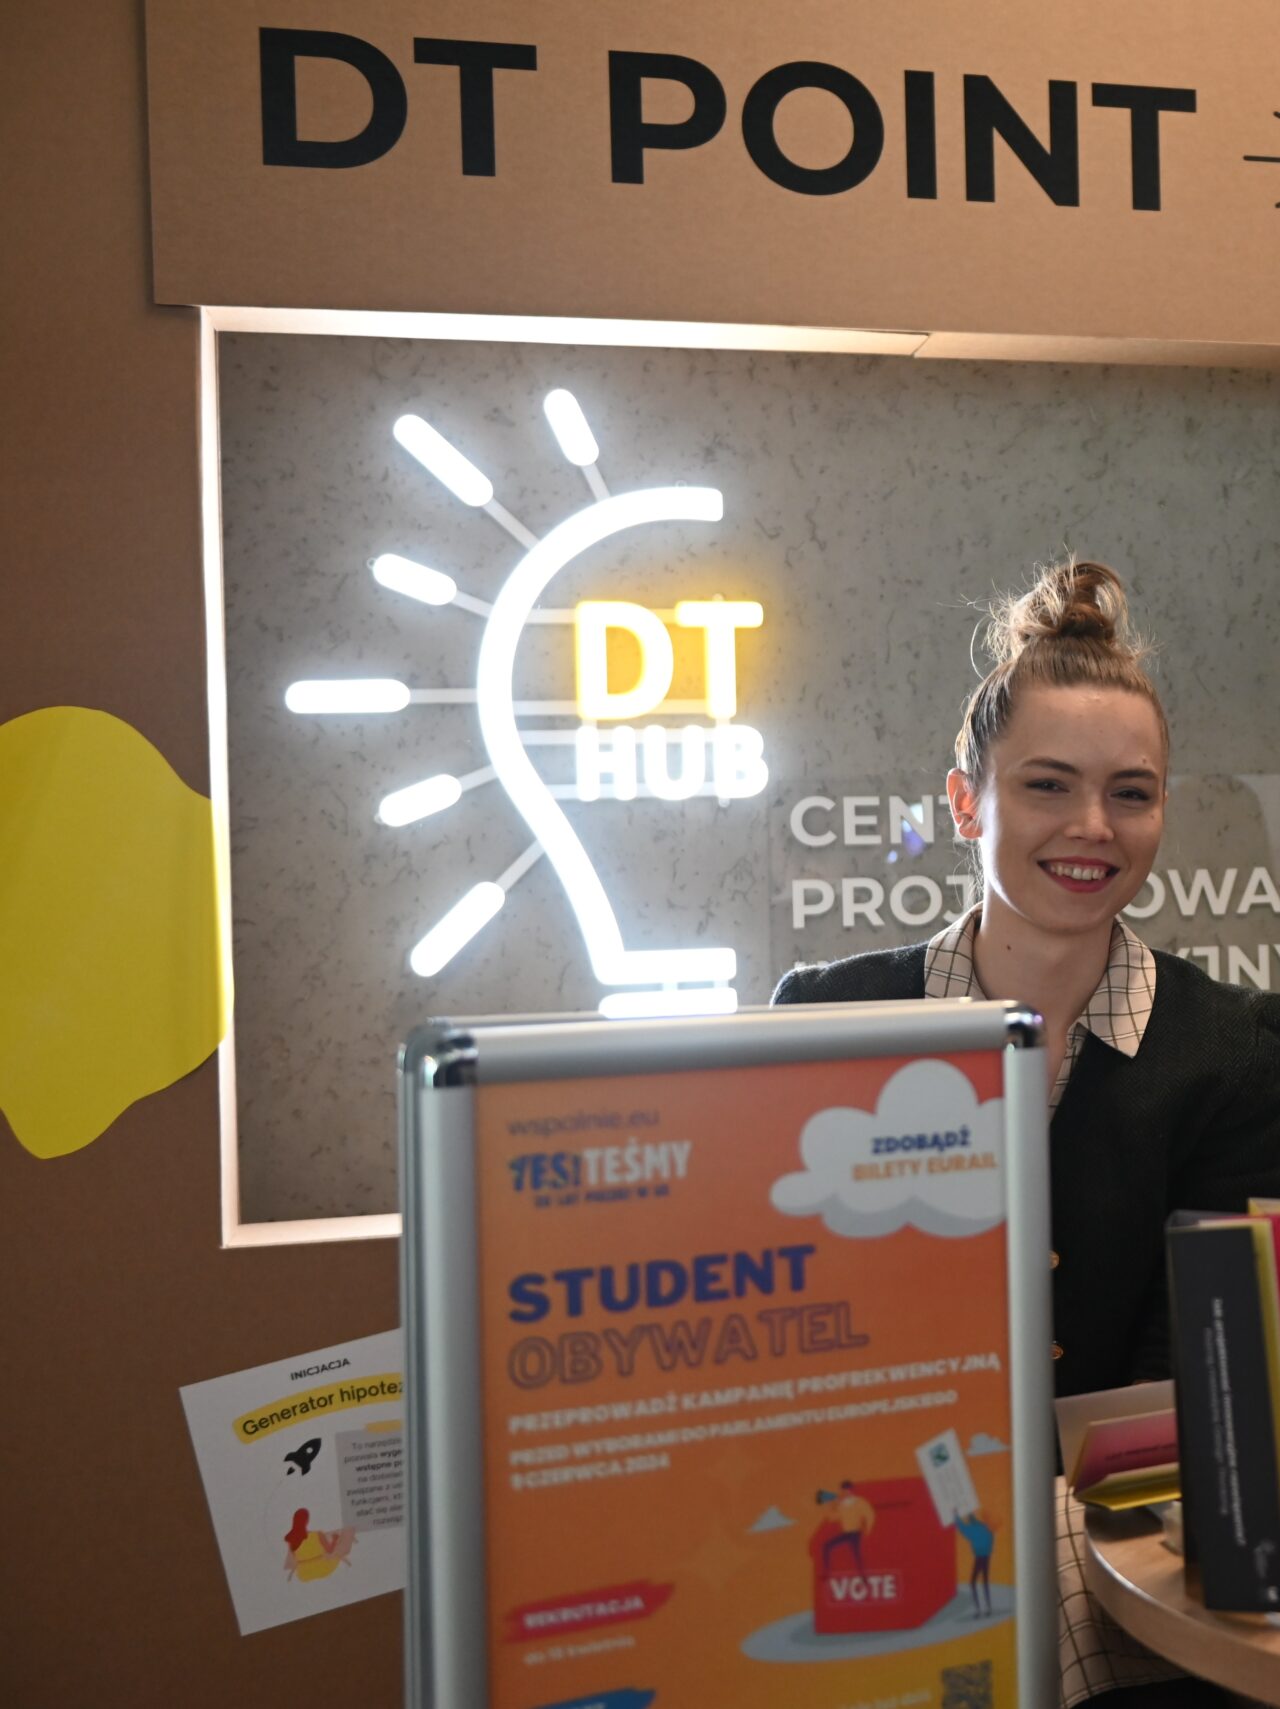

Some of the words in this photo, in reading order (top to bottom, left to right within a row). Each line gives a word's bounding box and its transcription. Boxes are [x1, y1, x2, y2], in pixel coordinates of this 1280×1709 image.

[259, 26, 538, 178] DT
[607, 48, 1198, 213] POINT
[574, 600, 764, 721] DT
[574, 723, 770, 802] HUB
[852, 1158, 921, 1183] BILETY
[926, 1151, 999, 1176] EURAIL
[508, 1244, 817, 1325] STUDENT
[290, 1357, 351, 1381] INICJACJA
[508, 1301, 870, 1390] OBYWATEL
[242, 1392, 335, 1436] Generator
[508, 1390, 679, 1434] PRZEPROWADŹ
[681, 1379, 795, 1412] KAMPANIĘ
[508, 1444, 570, 1467] PRZED
[572, 1427, 680, 1458] WYBORAMI
[681, 1425, 708, 1442] DO
[709, 1408, 827, 1438] PARLAMENTU
[524, 1458, 623, 1488] CZERWCA
[624, 1451, 671, 1474] 2024
[523, 1595, 646, 1629] REKRUTACJA
[830, 1574, 897, 1602] VOTE
